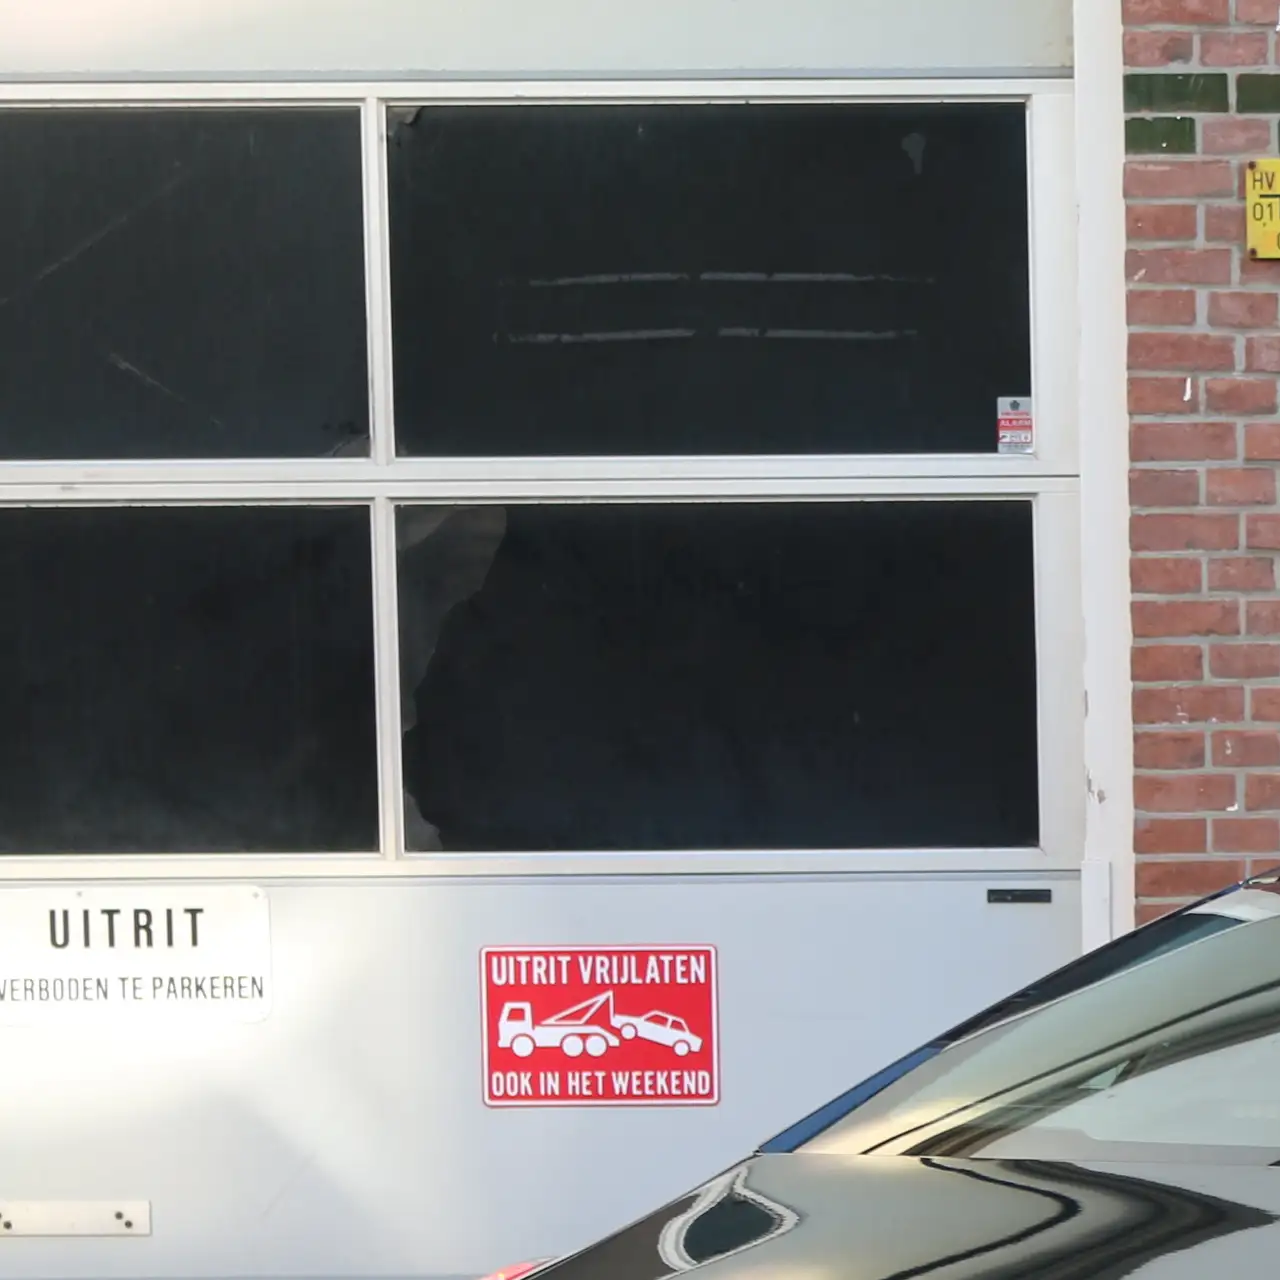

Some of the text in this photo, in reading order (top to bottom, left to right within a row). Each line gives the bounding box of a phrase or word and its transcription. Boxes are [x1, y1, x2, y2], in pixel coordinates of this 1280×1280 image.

[1252, 171, 1275, 191] HV
[1252, 202, 1274, 222] 01
[49, 908, 204, 949] UITRIT
[491, 954, 707, 986] UITRIT VRIJLATEN
[0, 975, 265, 1001] VERBODEN TE PARKEREN
[491, 1070, 711, 1097] OOK IN HET WEEKEND
